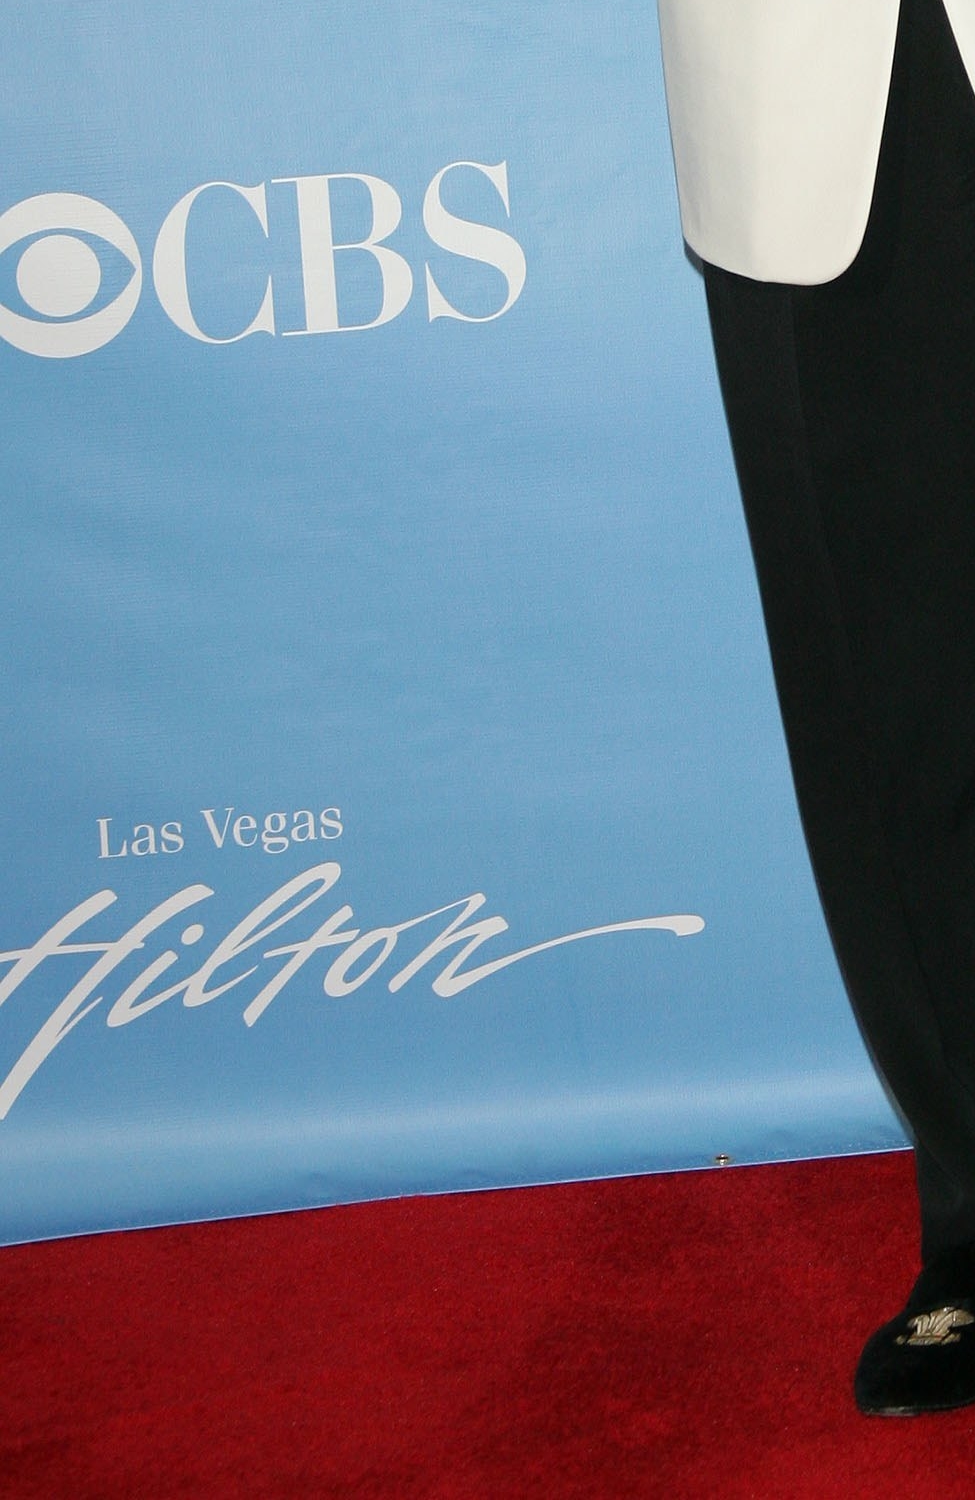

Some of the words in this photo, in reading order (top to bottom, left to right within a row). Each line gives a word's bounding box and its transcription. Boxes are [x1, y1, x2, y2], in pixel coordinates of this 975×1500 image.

[152, 160, 527, 344] CBS
[97, 816, 185, 859] Las
[200, 807, 344, 854] Vegas
[0, 862, 706, 1120] Hilton
